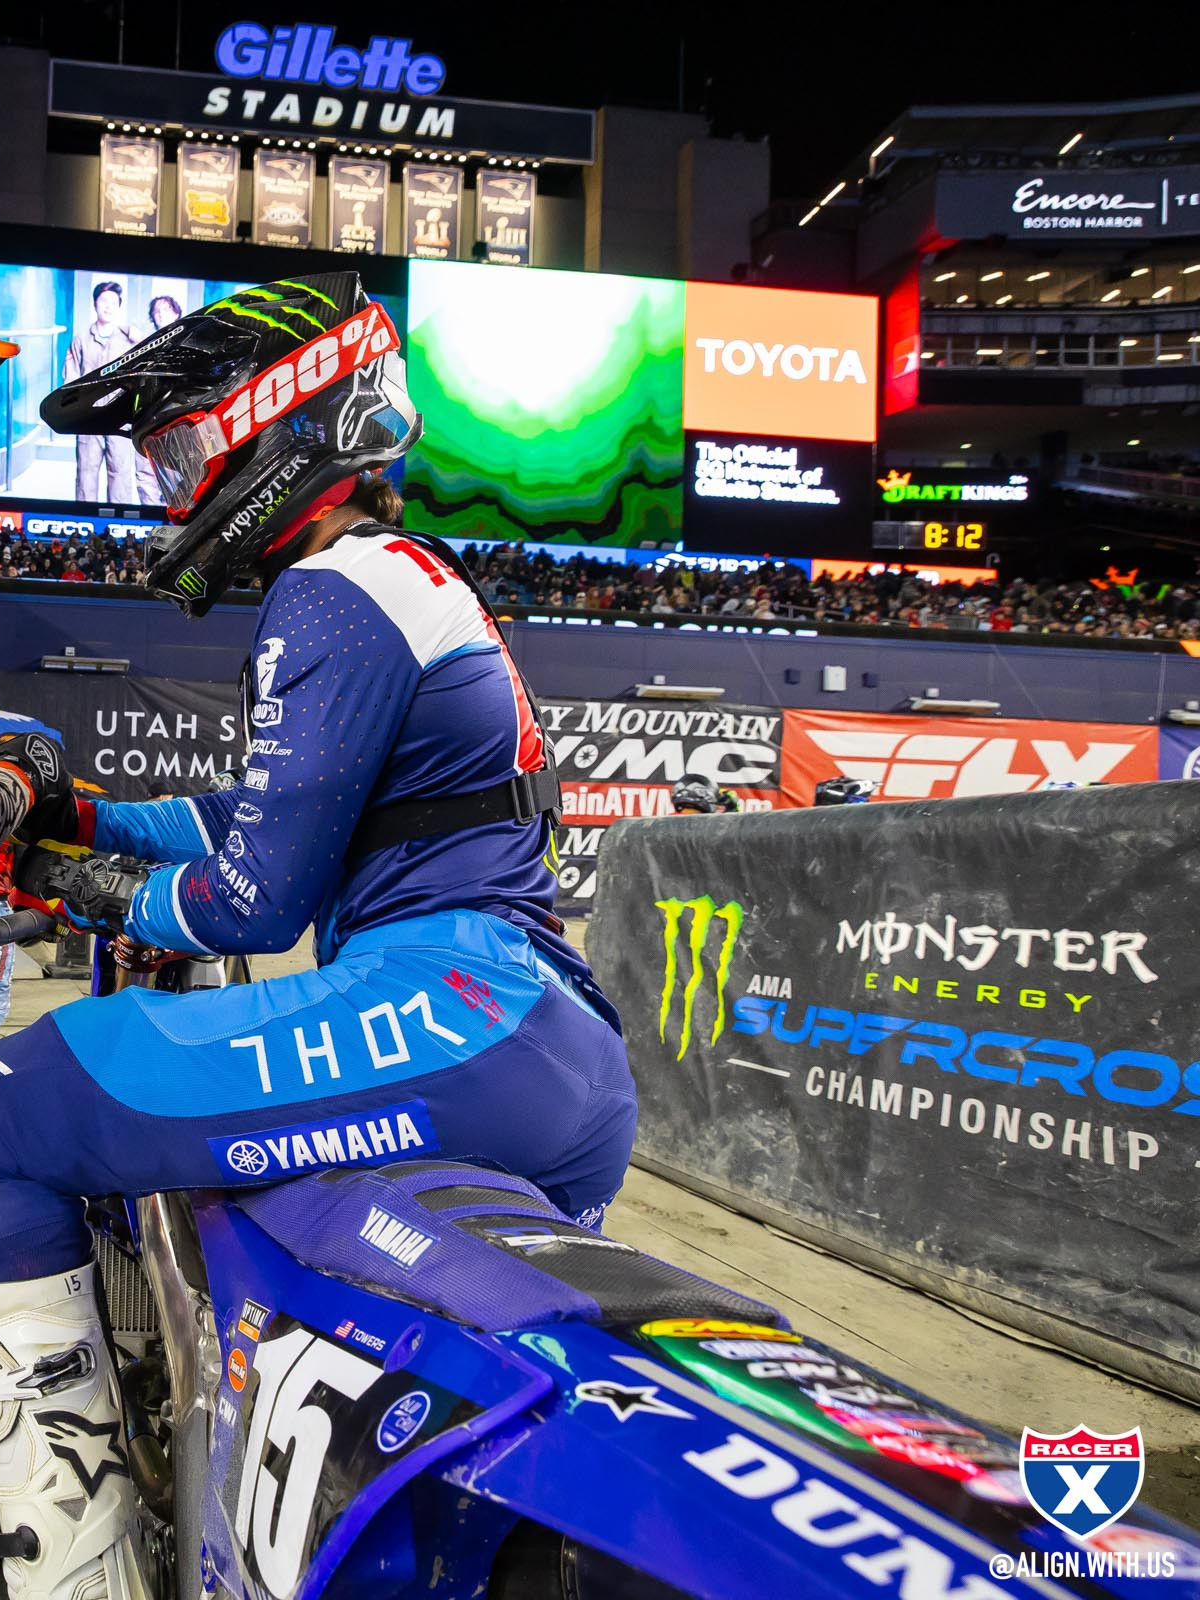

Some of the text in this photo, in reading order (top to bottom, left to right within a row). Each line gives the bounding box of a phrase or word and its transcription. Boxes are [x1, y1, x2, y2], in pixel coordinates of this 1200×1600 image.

[216, 22, 446, 95] Gillette
[204, 87, 456, 138] STADIUM
[1011, 178, 1156, 213] Encore
[1023, 216, 1144, 229] BOSTON HARBOR
[223, 308, 390, 445] 100%
[696, 338, 867, 384] TOYOTA
[222, 453, 310, 544] MONSTER
[258, 486, 294, 523] ARMY
[924, 522, 982, 549] 8:12
[96, 710, 198, 740] UTAH
[574, 701, 782, 742] MOUNTAIN
[804, 729, 1137, 800] FLY
[836, 911, 1159, 984] MONSTER
[746, 974, 793, 1000] AMA
[864, 972, 1093, 1013] ENERGY
[731, 997, 1200, 1117] SUPERCRO
[265, 1112, 425, 1170] YAMAHA
[805, 1066, 1160, 1172] CHAMPIONSHIP
[358, 1206, 435, 1266] YAMAHA
[64, 1274, 81, 1295] 15
[242, 1302, 266, 1328] OPTIMA
[351, 1328, 386, 1351] TOWERS
[235, 1327, 385, 1600] 15
